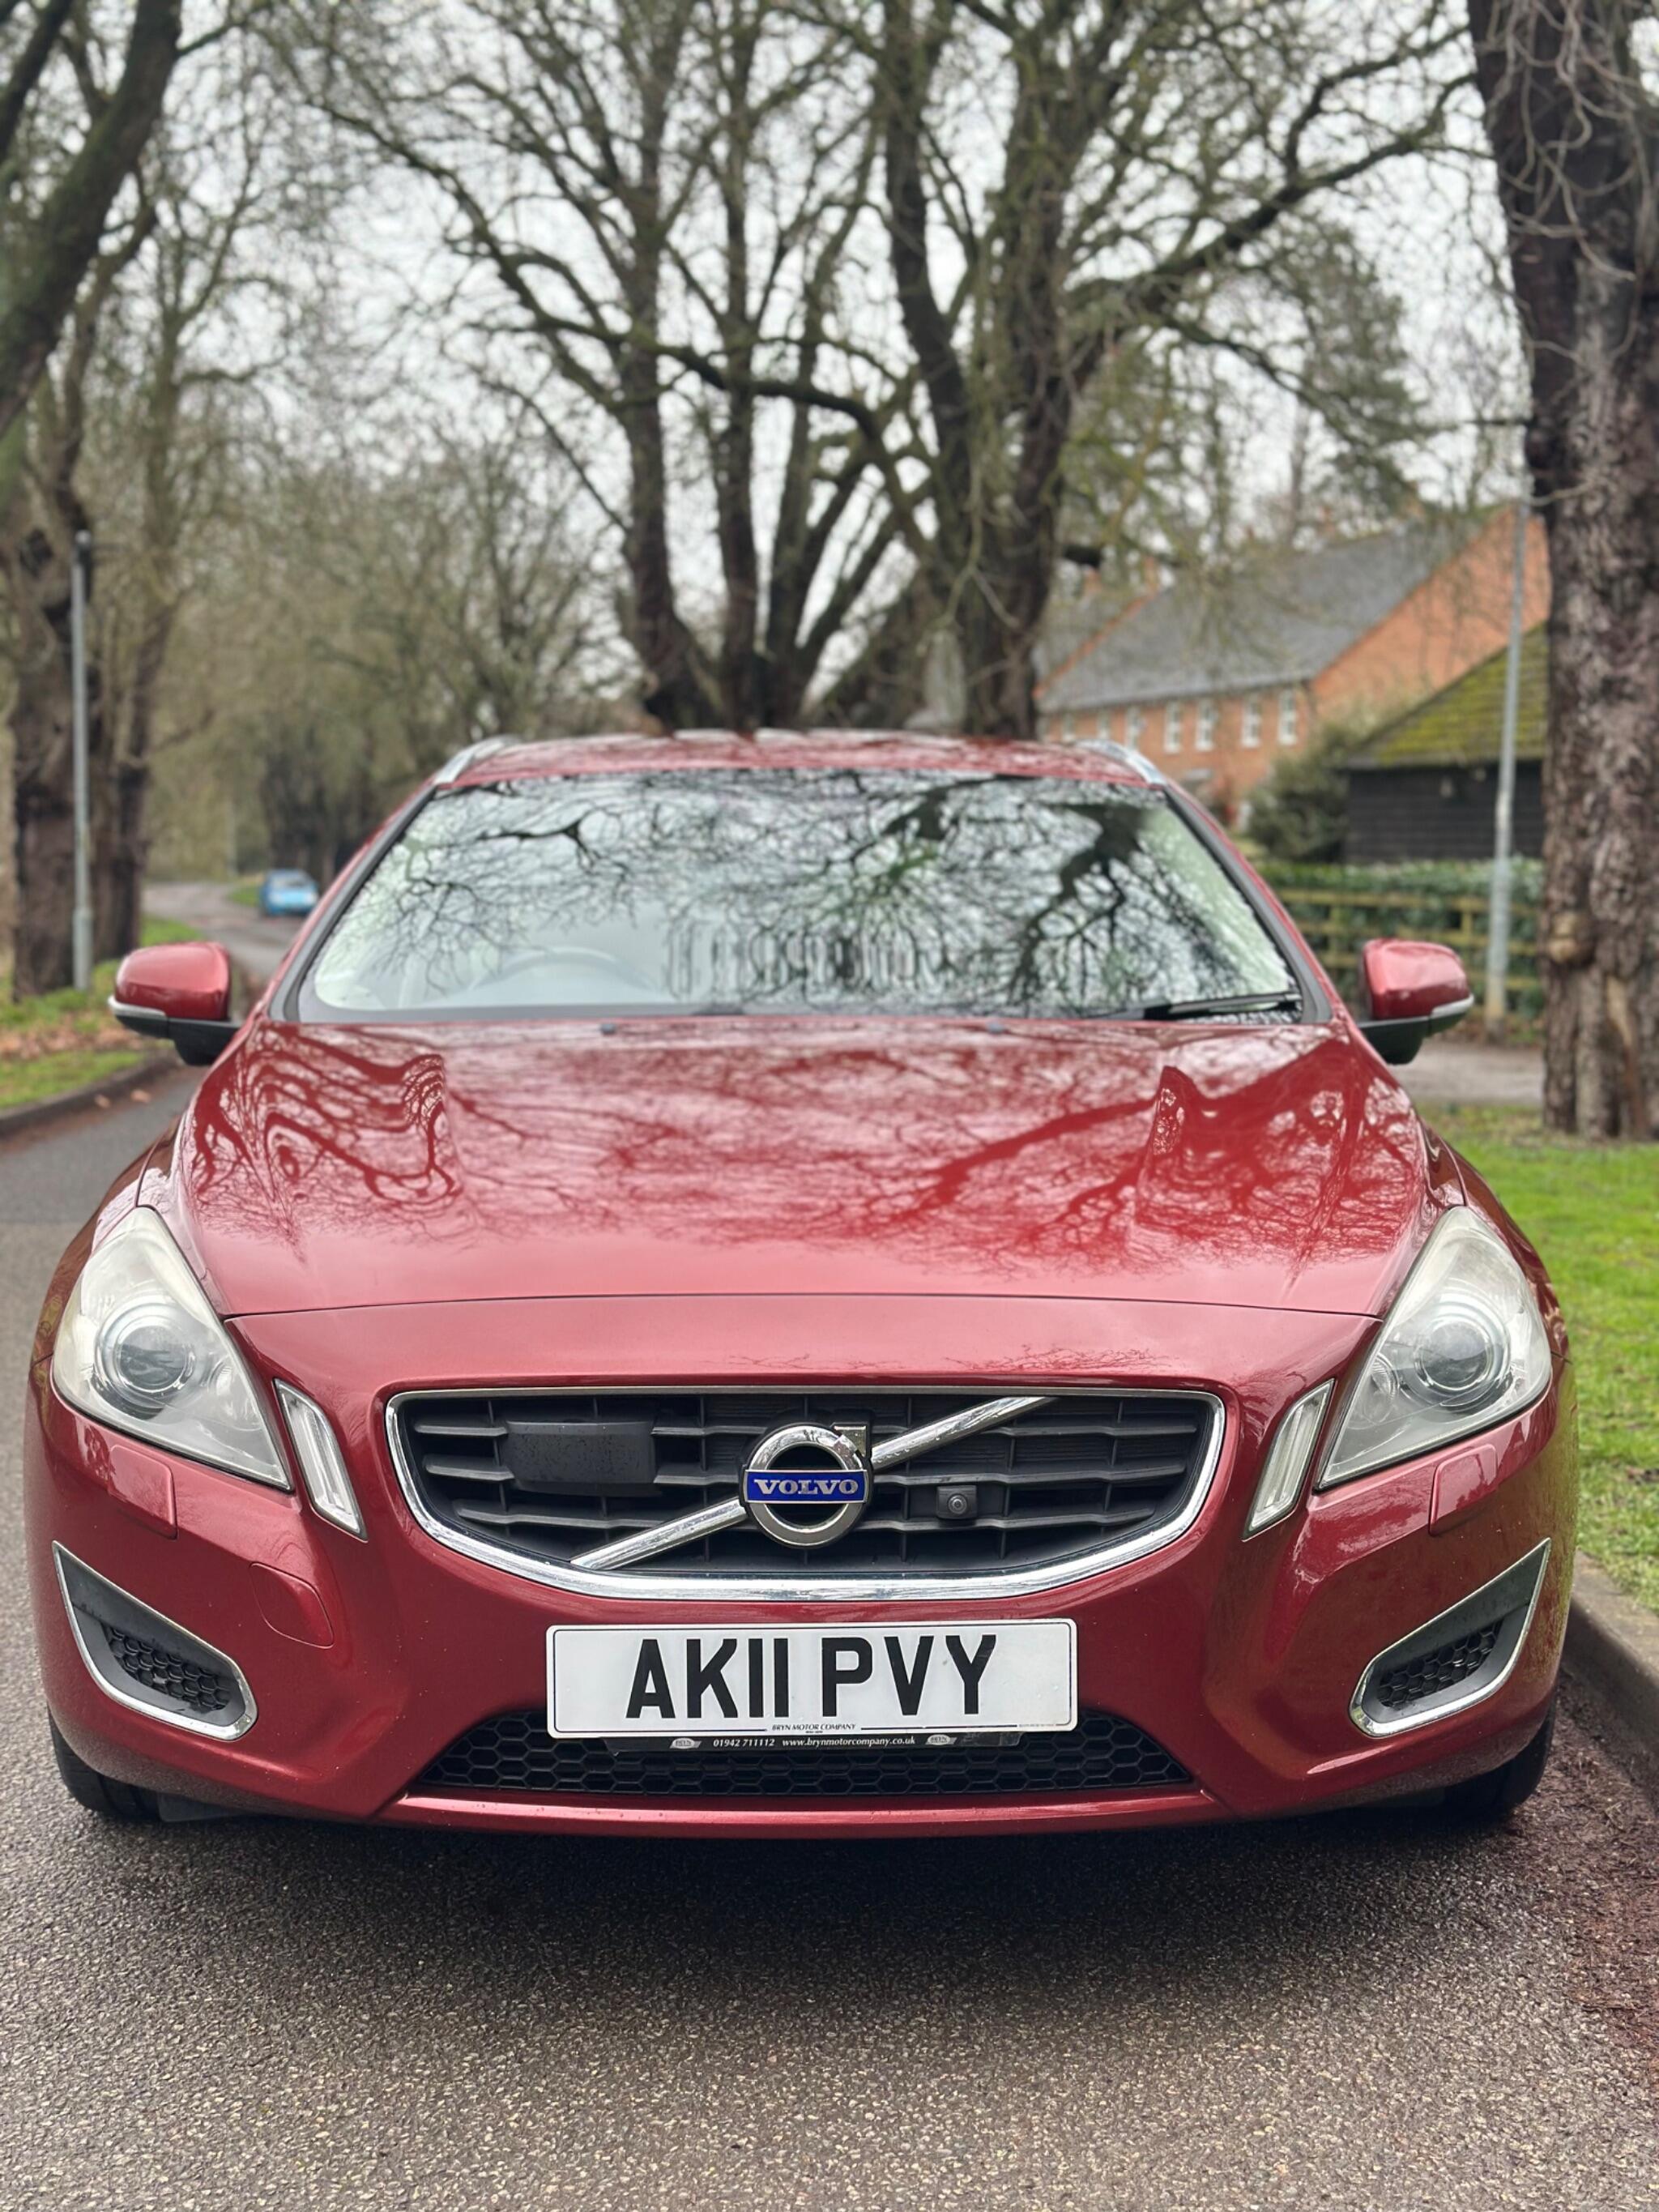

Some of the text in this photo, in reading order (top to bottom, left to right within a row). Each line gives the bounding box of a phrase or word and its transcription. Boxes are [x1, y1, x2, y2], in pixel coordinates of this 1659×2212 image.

[753, 1479, 859, 1495] VOLVO
[625, 1634, 996, 1719] AK11 PVY
[714, 1735, 915, 1748] 01942 711112 www.brynmotorcompany.co.uk
